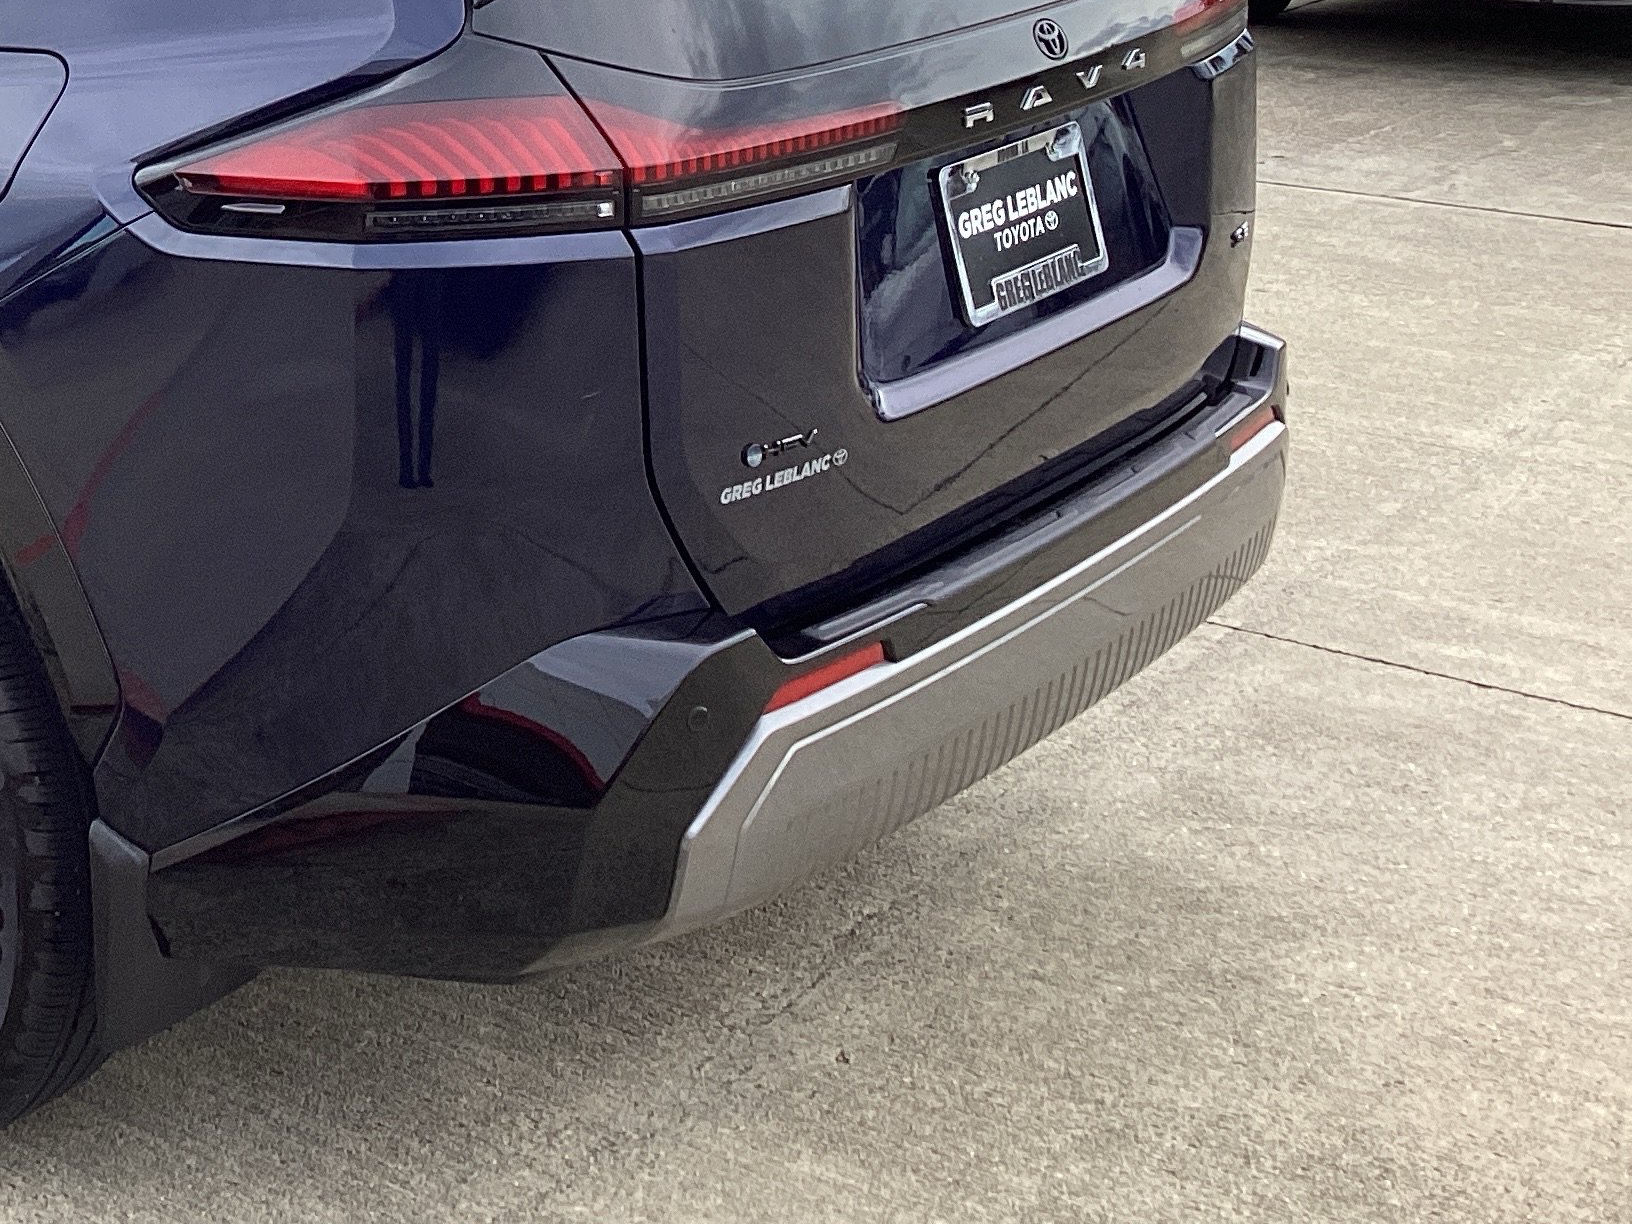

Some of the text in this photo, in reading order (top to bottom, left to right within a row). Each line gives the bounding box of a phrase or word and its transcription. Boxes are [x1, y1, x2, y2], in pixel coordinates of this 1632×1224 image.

[962, 48, 1147, 129] RAV4
[957, 171, 1079, 239] GREG LEBLANC
[993, 217, 1046, 252] TOYOTA
[719, 453, 832, 505] GREG LEBLANC
